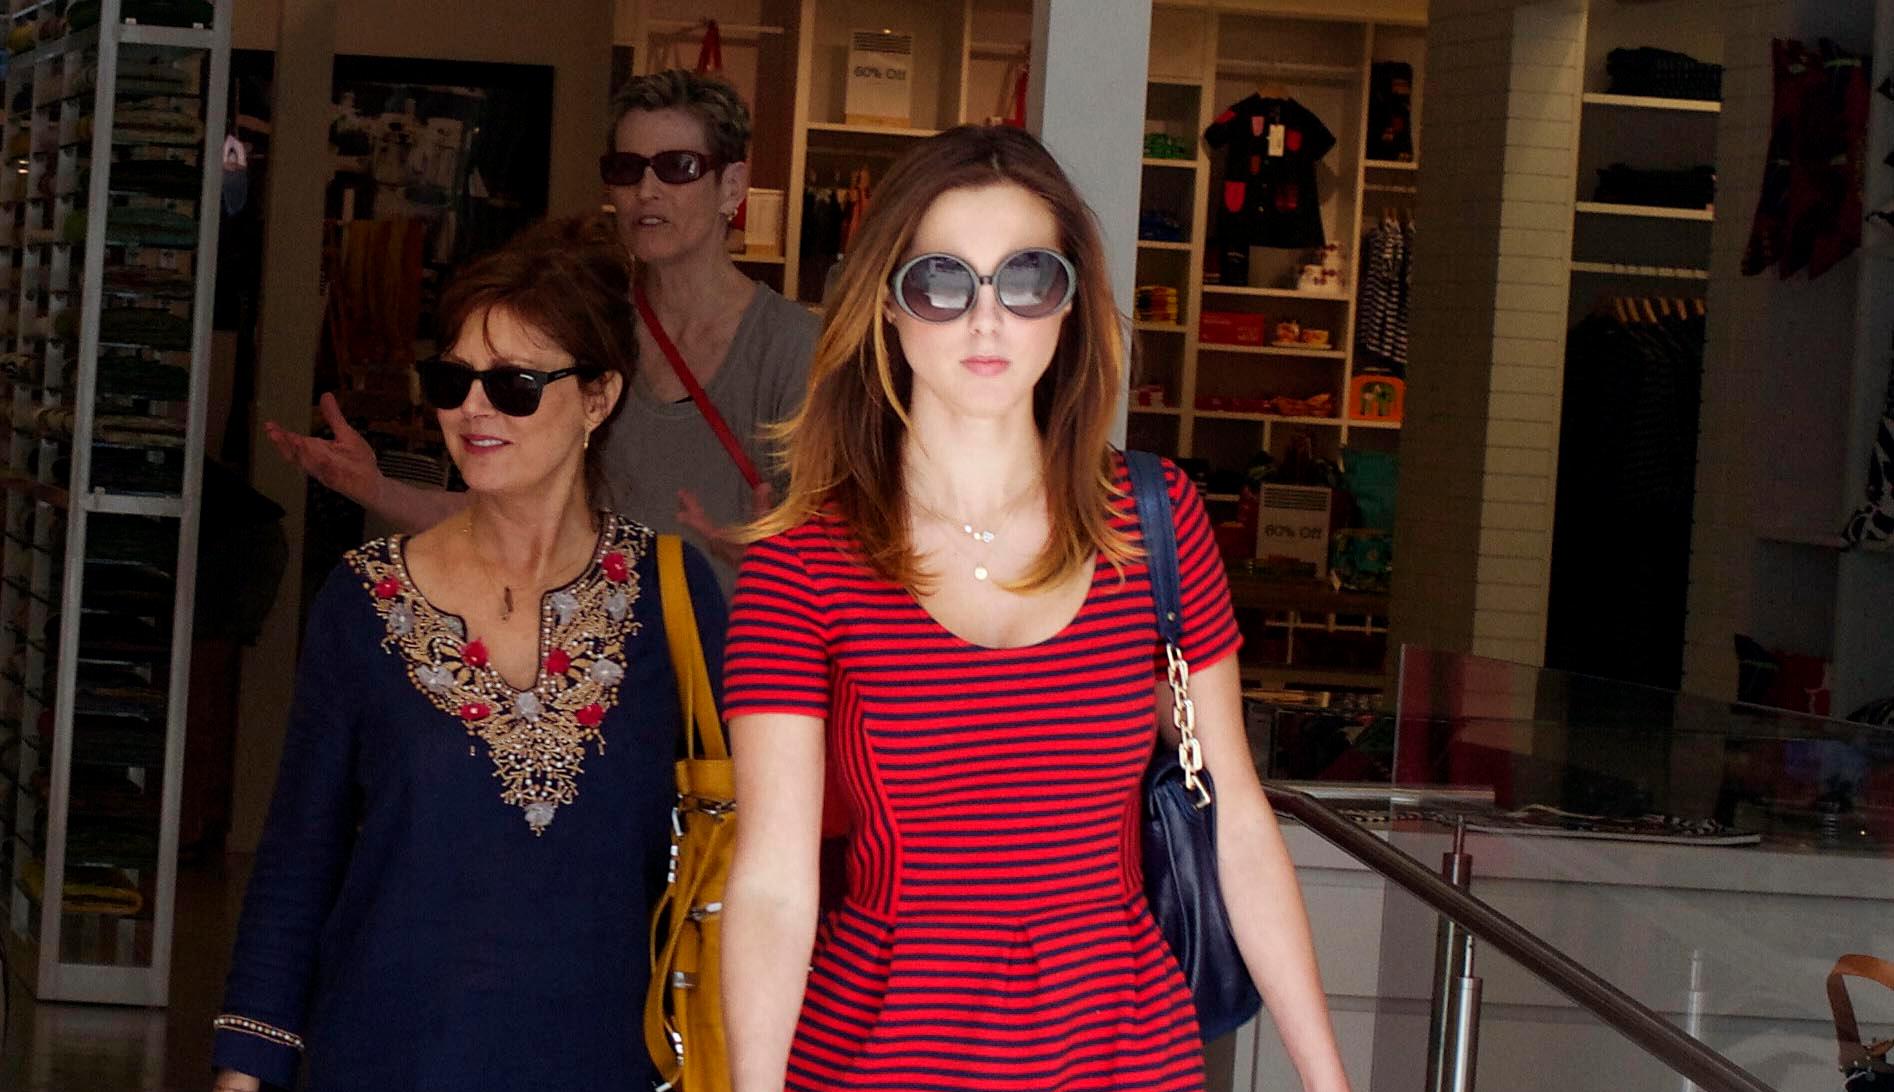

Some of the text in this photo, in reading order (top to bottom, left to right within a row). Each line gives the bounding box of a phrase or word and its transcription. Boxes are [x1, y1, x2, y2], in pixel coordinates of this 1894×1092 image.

[853, 66, 906, 80] 60% Off
[1265, 525, 1295, 537] 60%
